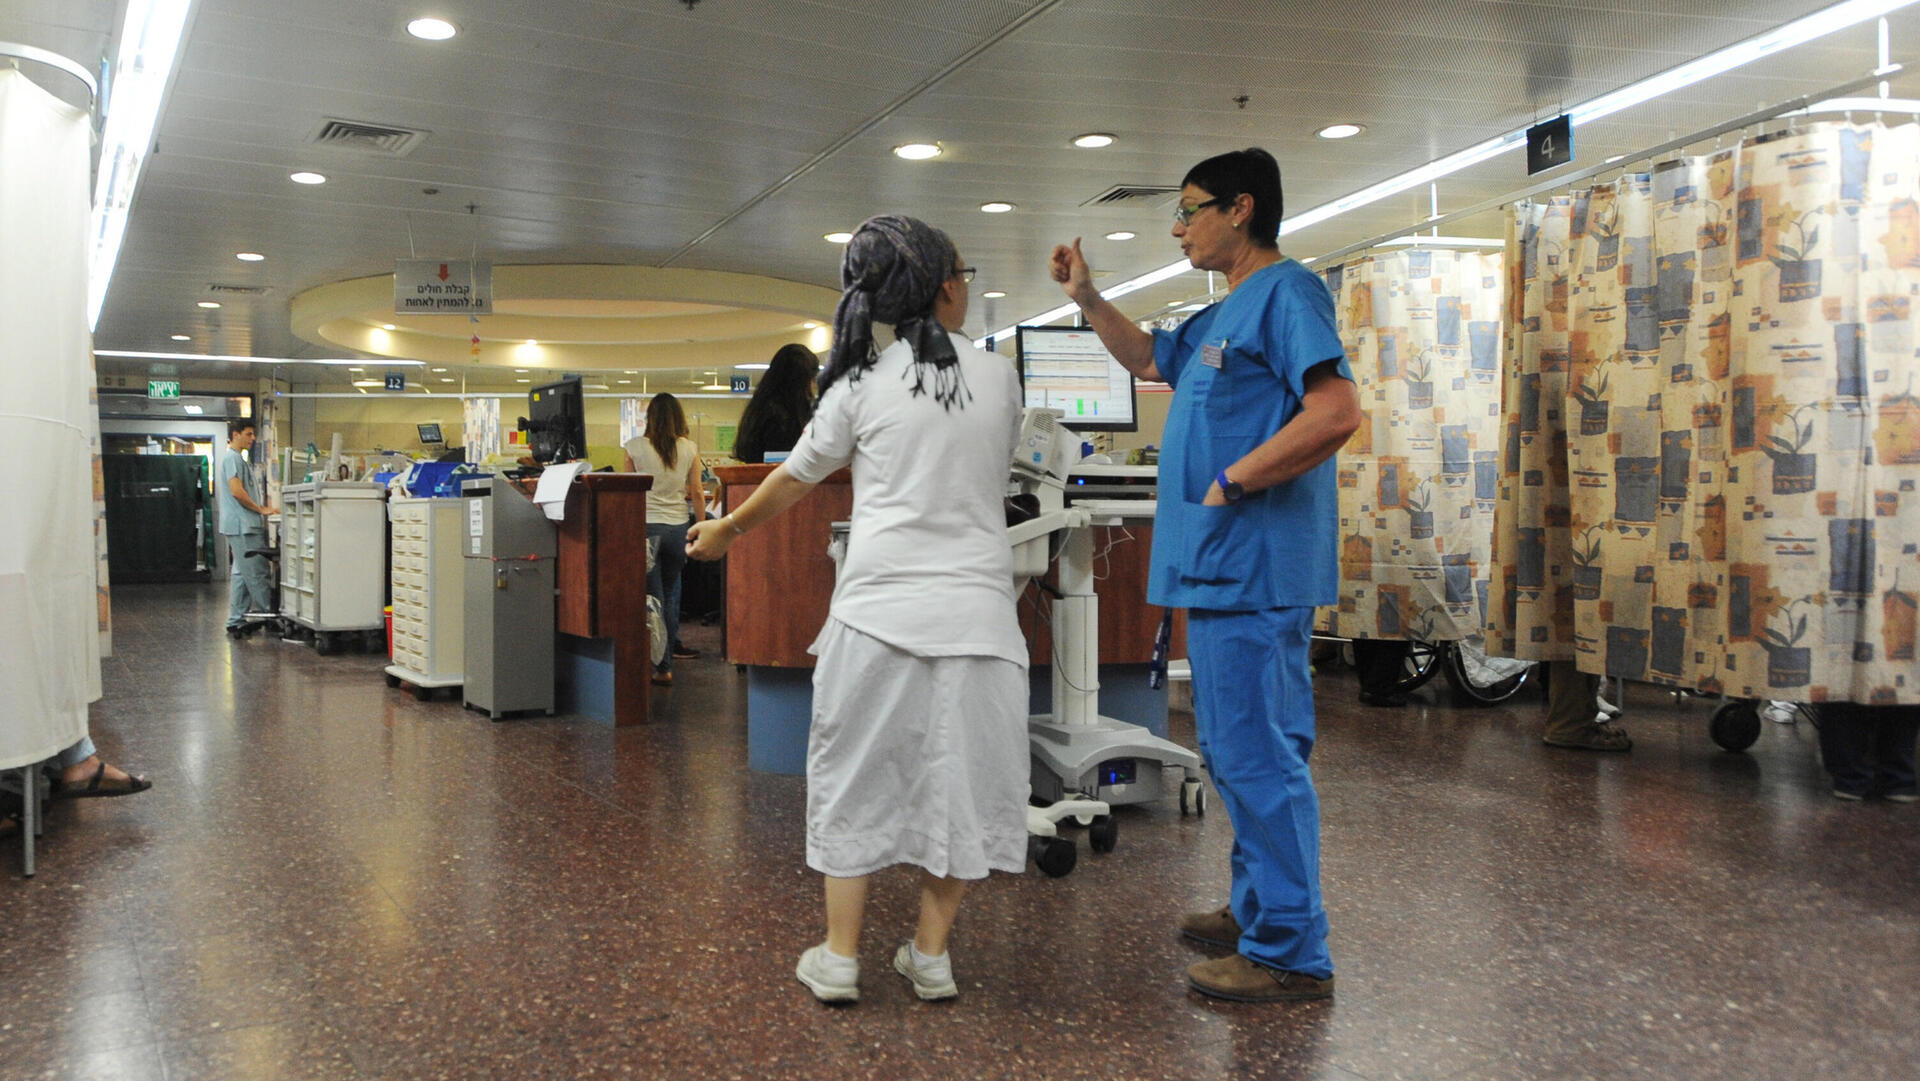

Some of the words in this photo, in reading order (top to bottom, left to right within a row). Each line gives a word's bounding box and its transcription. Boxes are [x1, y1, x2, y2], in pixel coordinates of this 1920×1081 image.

[1541, 134, 1556, 160] 4
[417, 284, 442, 294] חולים
[445, 284, 470, 296] קבלת
[405, 296, 434, 307] לאחות
[437, 297, 469, 308] להמתין
[388, 378, 400, 388] 12
[734, 381, 746, 390] 10
[150, 381, 177, 399] יציאה
